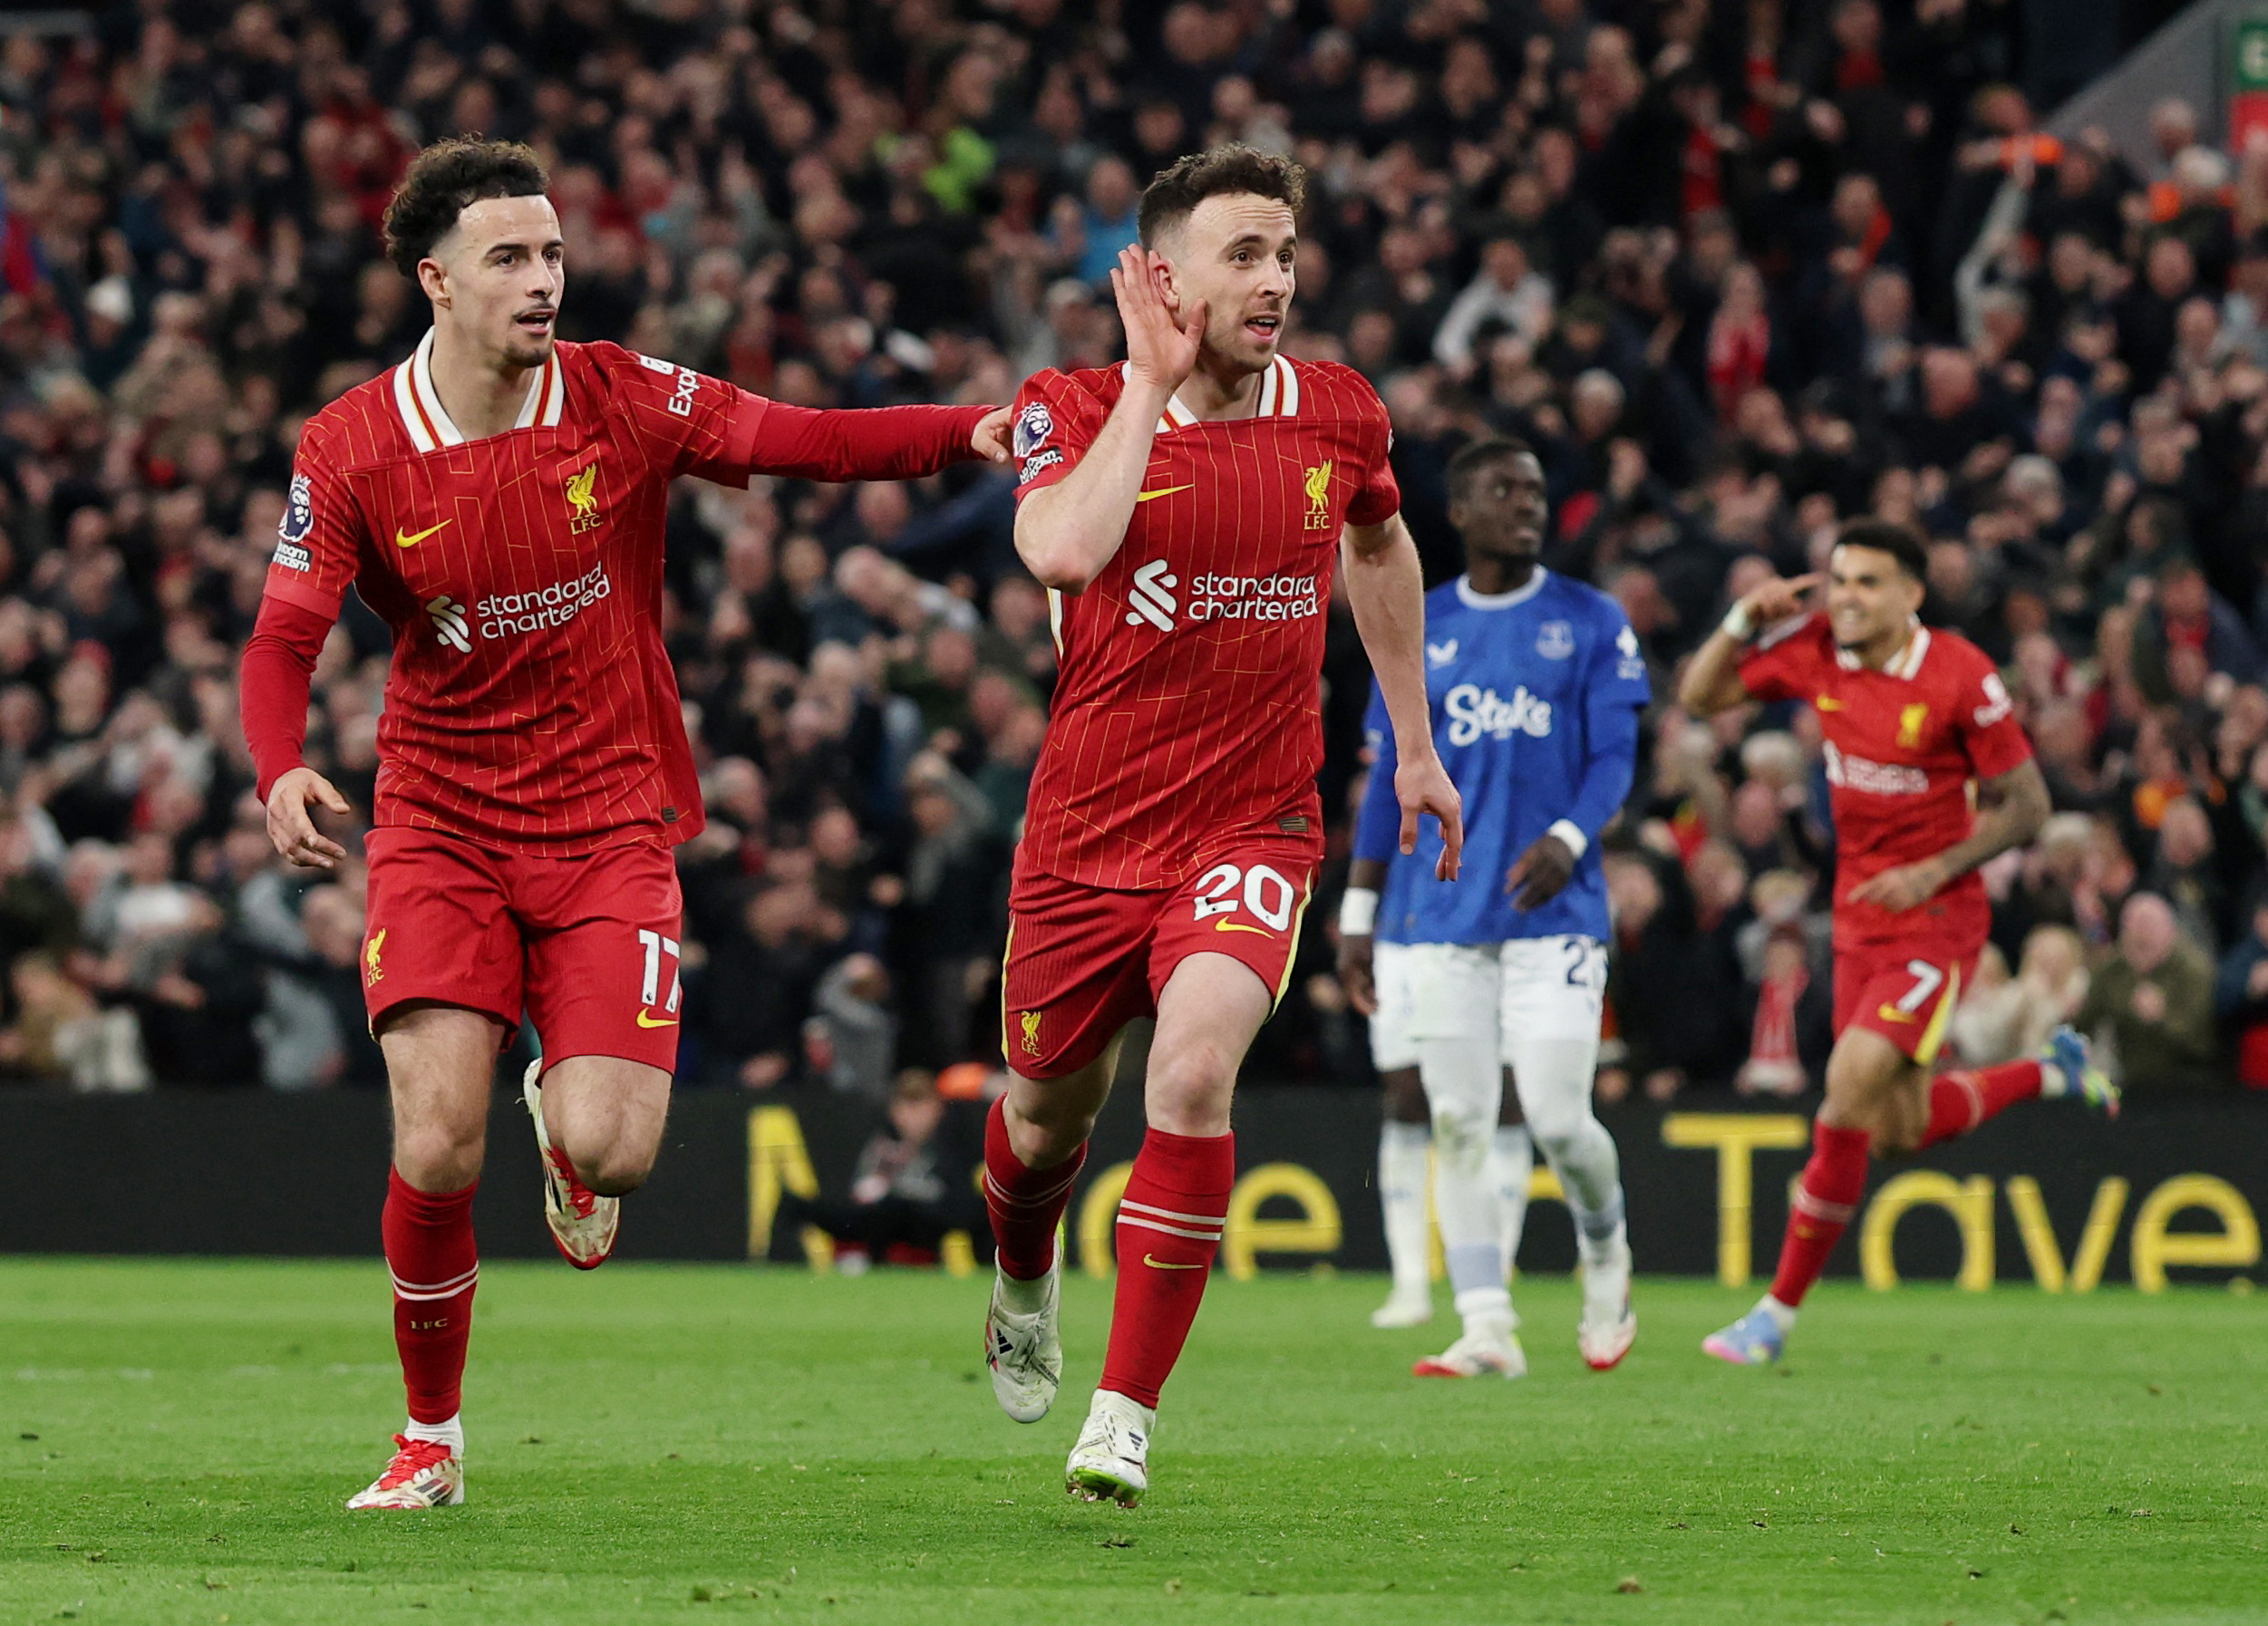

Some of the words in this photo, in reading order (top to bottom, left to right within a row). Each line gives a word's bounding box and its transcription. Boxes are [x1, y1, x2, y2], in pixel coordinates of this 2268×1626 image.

[476, 560, 602, 617] standard
[481, 574, 611, 639] chartered
[1188, 592, 1319, 621] chartered
[1190, 570, 1317, 597] standard
[1444, 682, 1553, 747] Stake
[1193, 863, 1294, 932] 20
[639, 928, 680, 1013] 17
[1895, 958, 1943, 1012] 7
